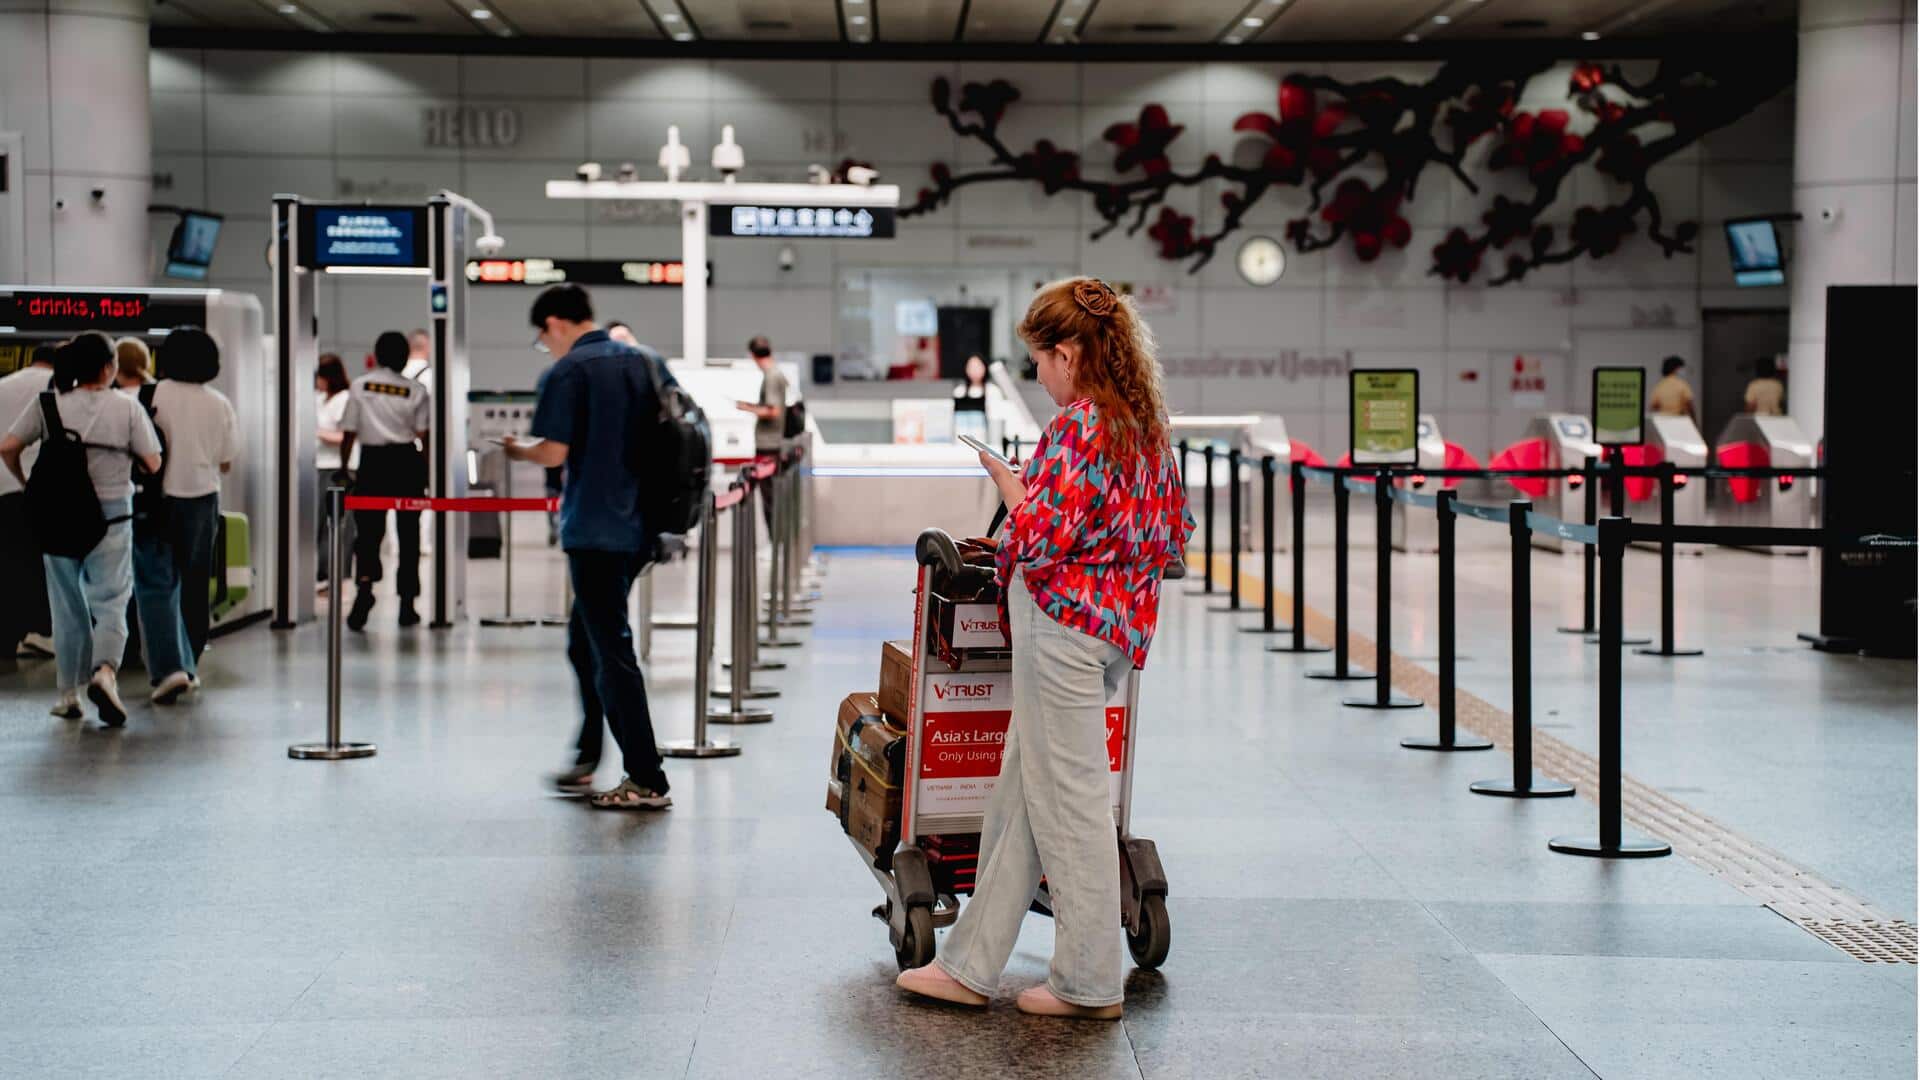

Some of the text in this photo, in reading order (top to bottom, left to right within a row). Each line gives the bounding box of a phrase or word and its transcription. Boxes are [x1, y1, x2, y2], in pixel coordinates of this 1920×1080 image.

[423, 107, 519, 146] HELLO
[29, 296, 95, 319] drinks,
[931, 730, 970, 743] Asia's
[938, 751, 964, 763] Only
[967, 751, 996, 762] Using
